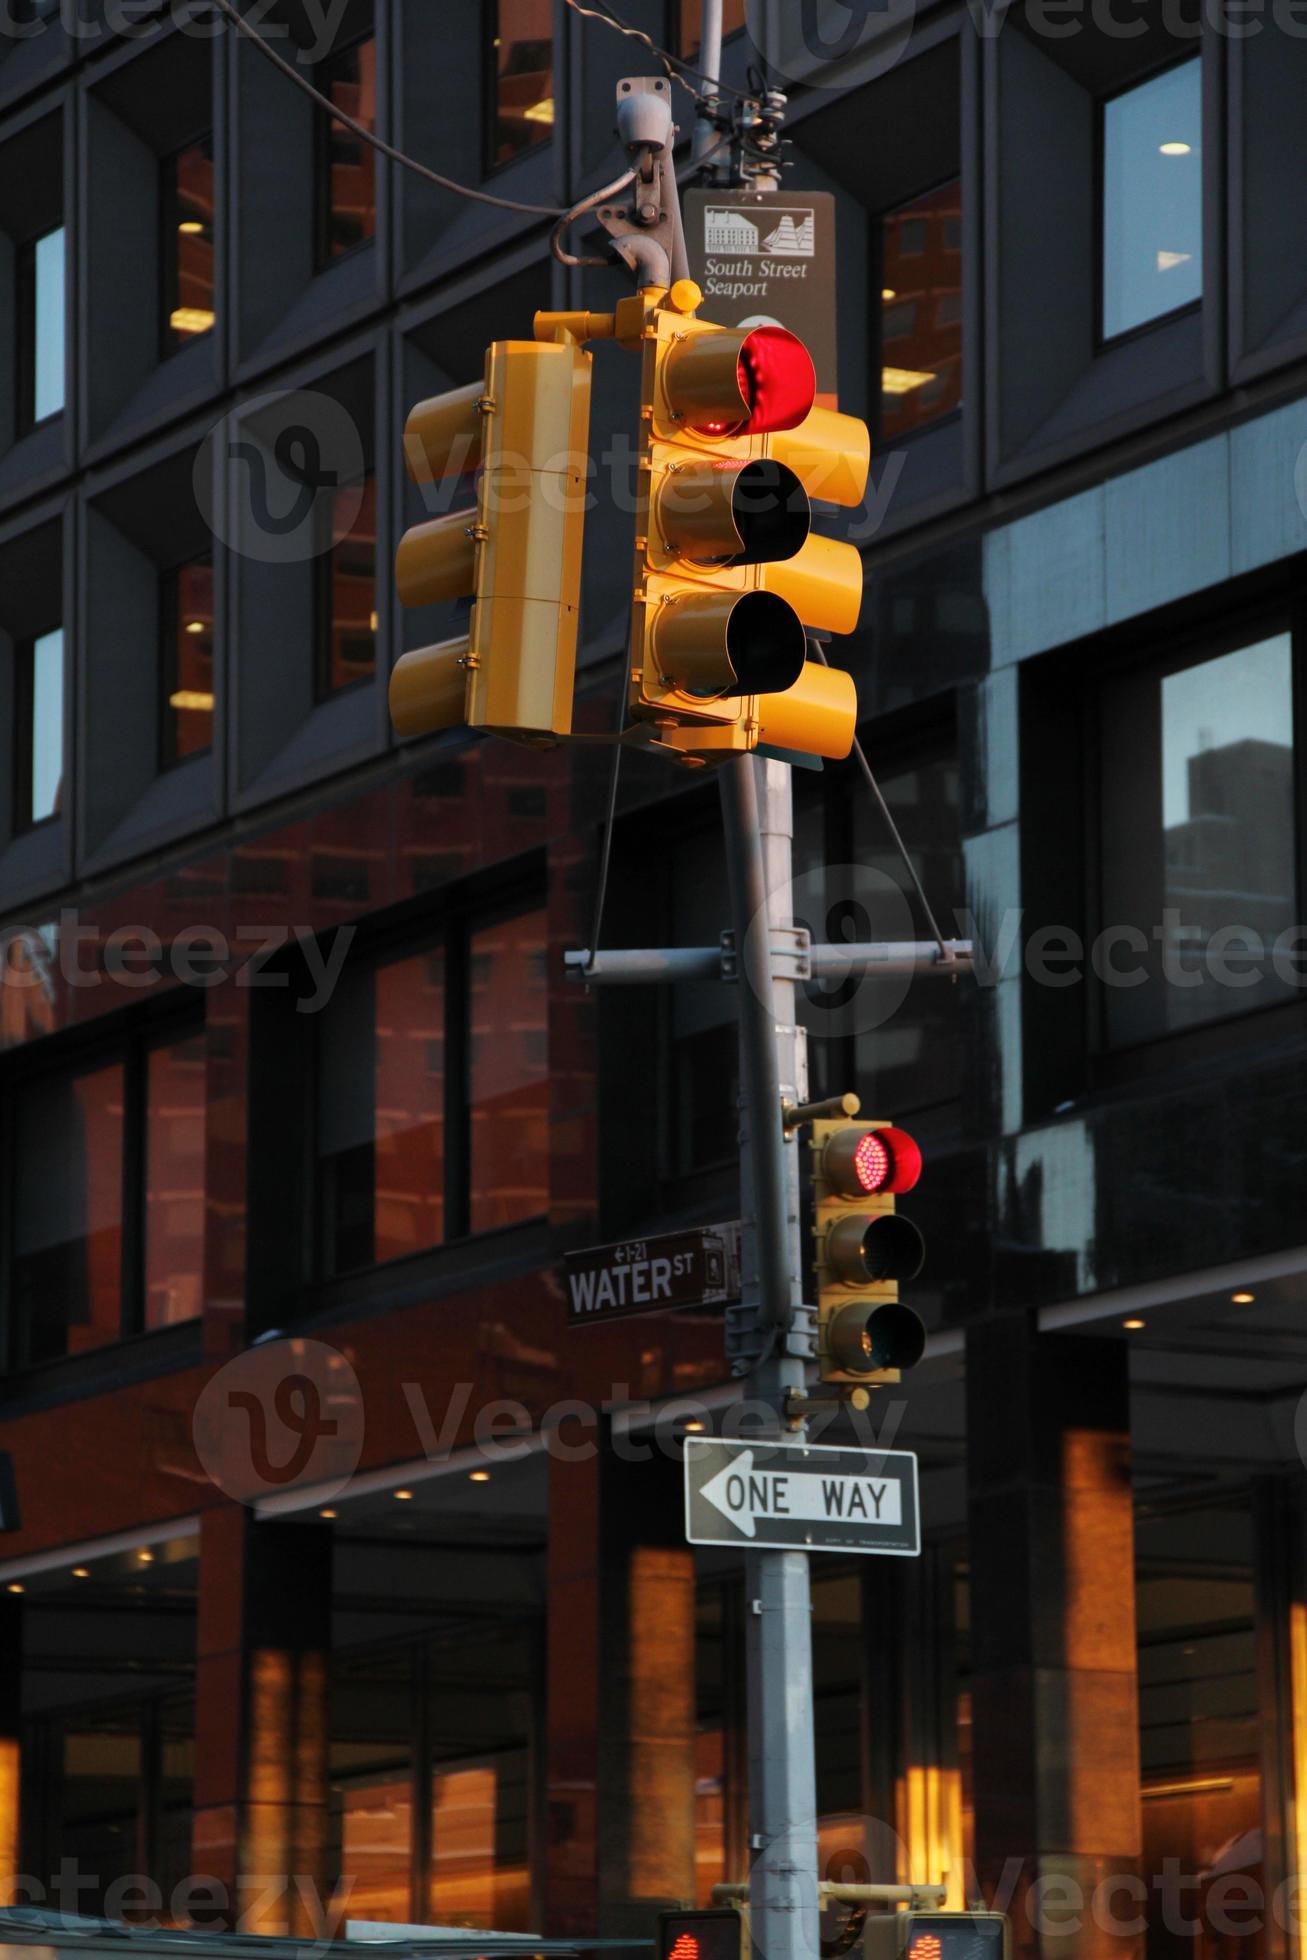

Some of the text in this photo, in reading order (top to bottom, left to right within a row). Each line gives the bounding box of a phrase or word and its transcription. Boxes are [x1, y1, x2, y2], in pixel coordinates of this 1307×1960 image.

[704, 258, 808, 278] South Street
[704, 277, 768, 299] Seaport
[569, 1252, 694, 1313] WATER ST
[726, 1474, 887, 1519] ONE WAY
